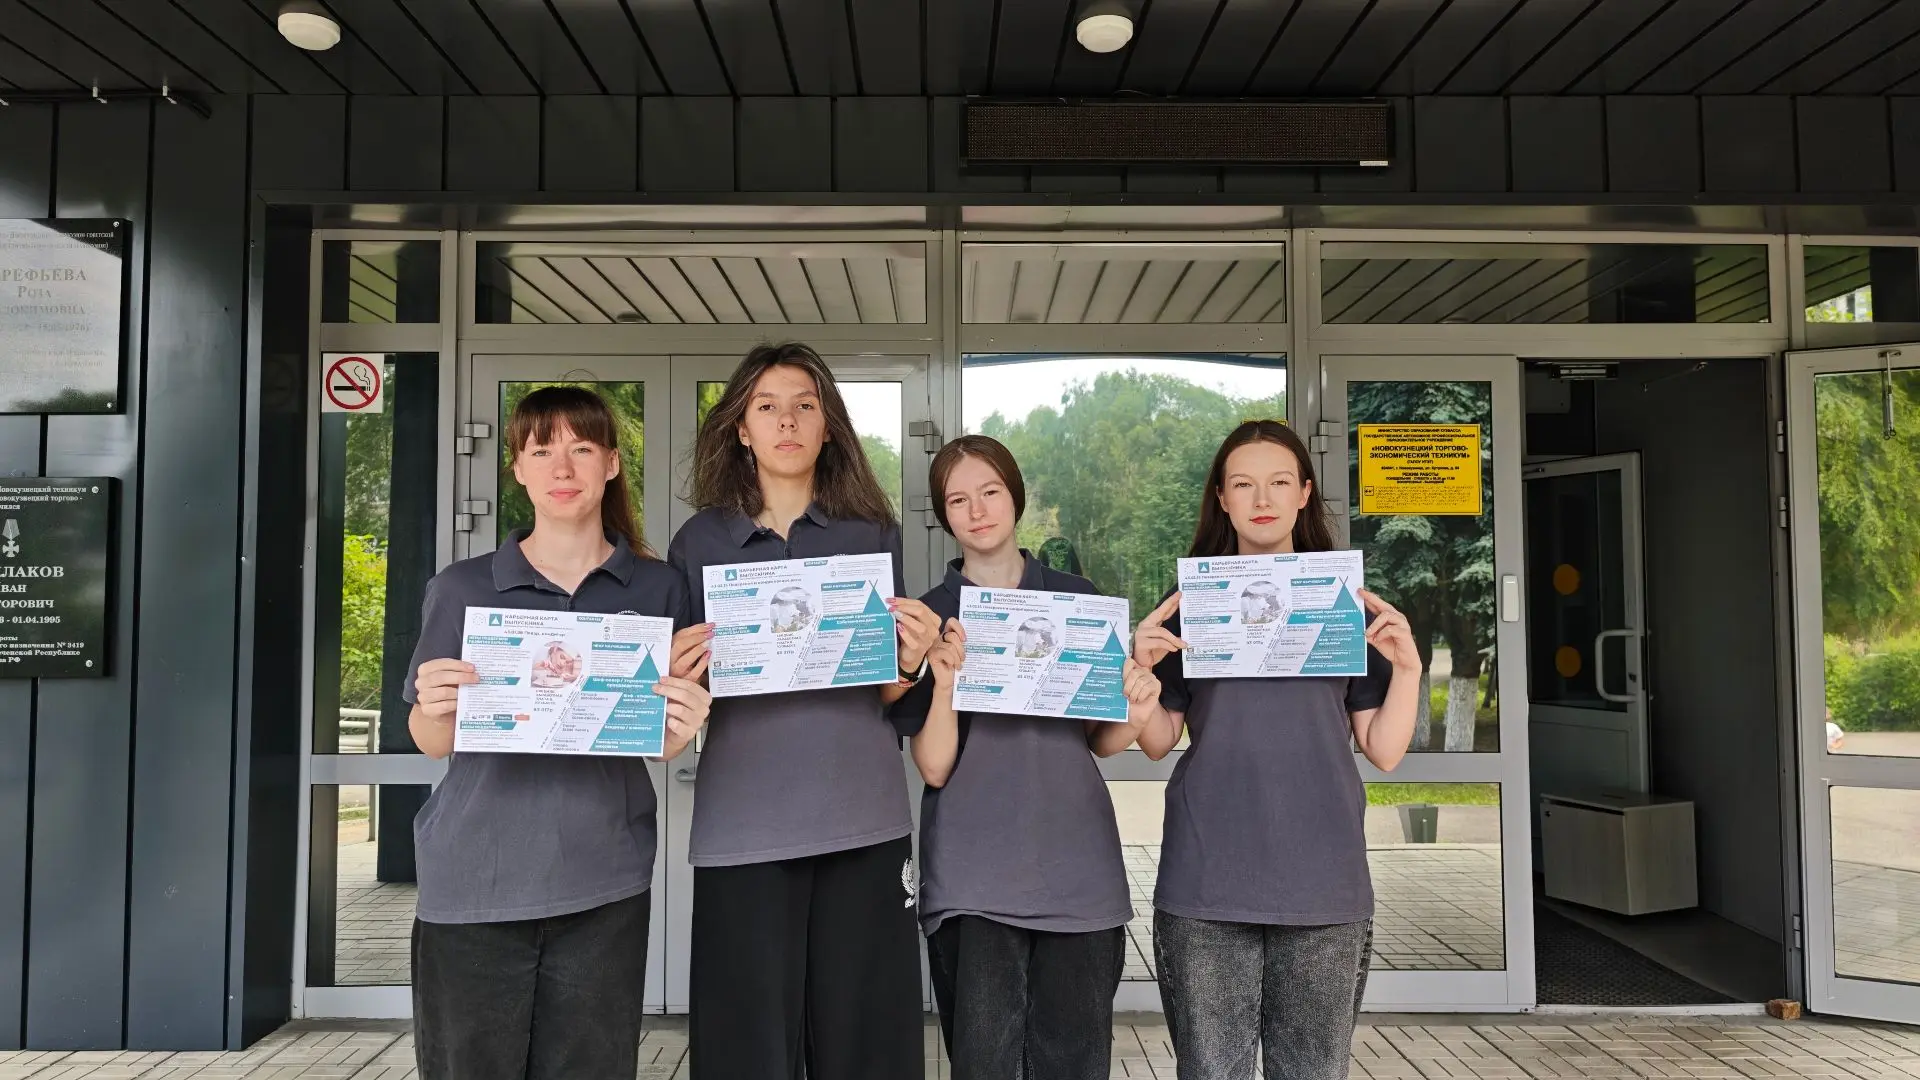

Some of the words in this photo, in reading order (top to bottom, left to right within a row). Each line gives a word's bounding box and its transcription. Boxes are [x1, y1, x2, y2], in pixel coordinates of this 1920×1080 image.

[0, 566, 65, 578] ЛАКОВ
[0, 584, 27, 593] ВАН
[0, 600, 55, 608] ОРОВИЧ
[12, 616, 61, 624] 01.04.1995
[34, 649, 81, 657] Республике
